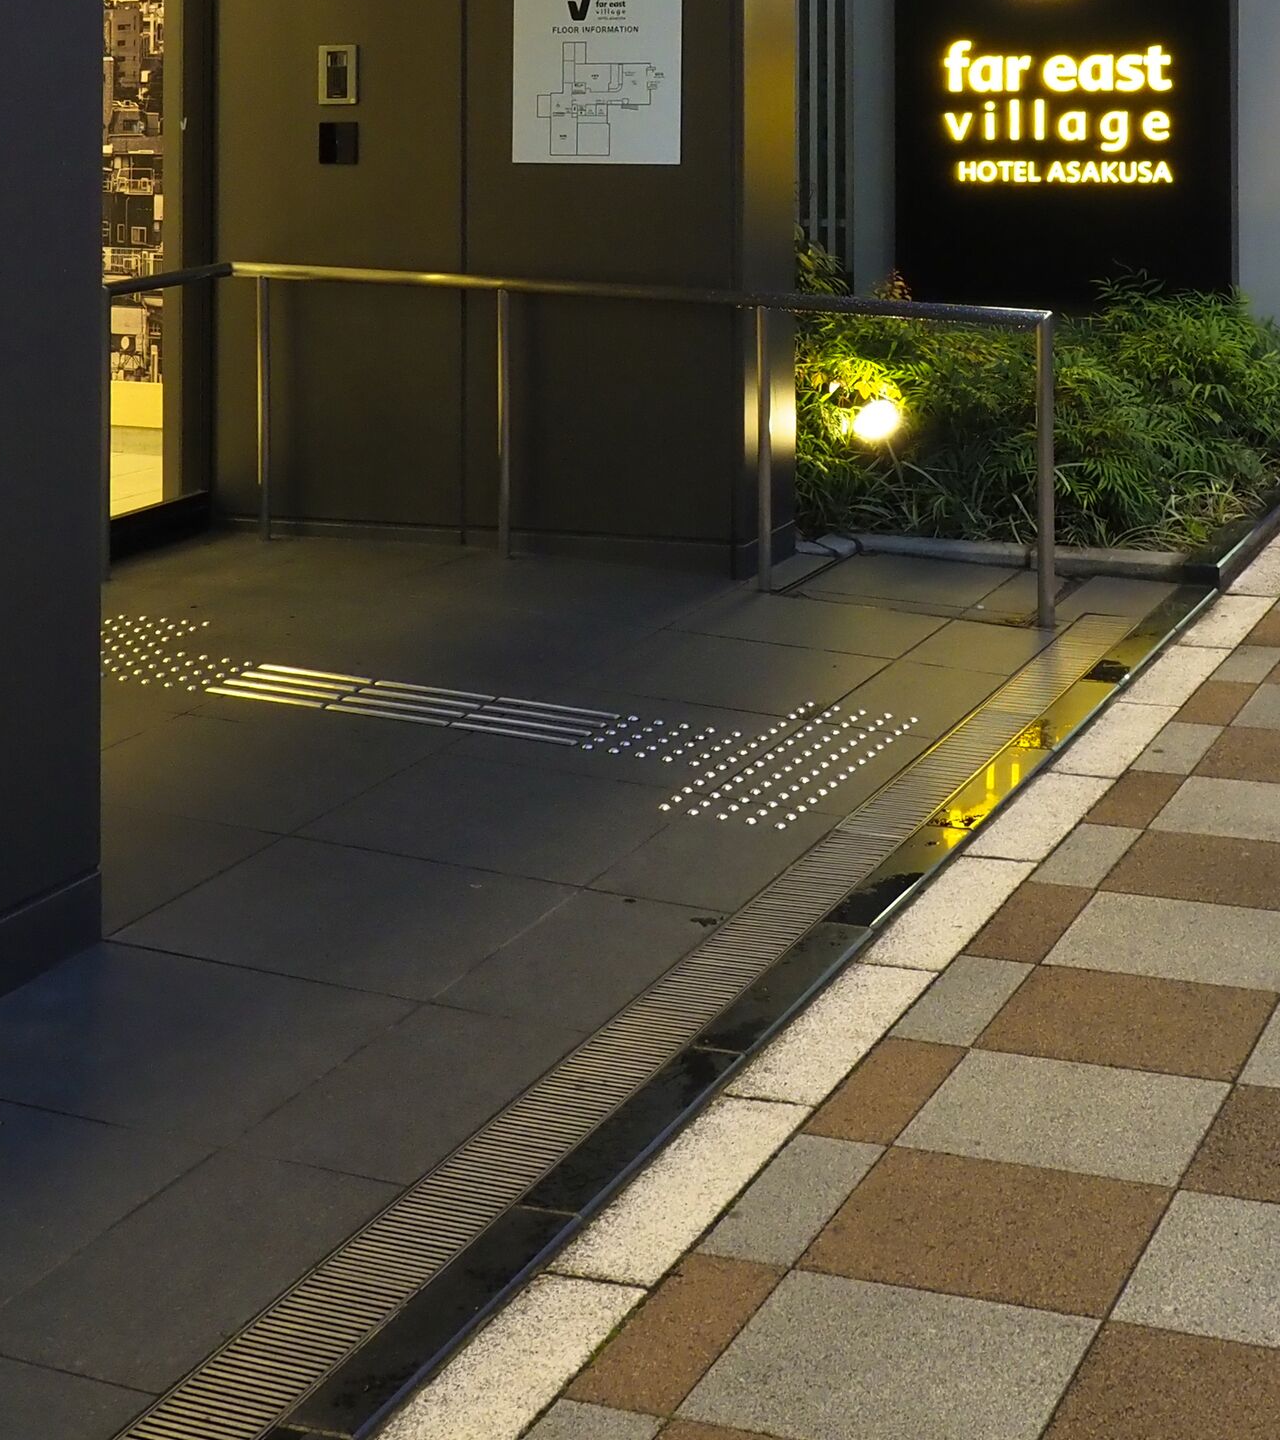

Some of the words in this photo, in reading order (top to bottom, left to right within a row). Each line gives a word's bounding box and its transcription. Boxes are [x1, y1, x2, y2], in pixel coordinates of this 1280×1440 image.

[596, 0, 607, 8] far
[609, 0, 626, 8] east
[552, 26, 579, 34] FLOOR
[582, 25, 639, 34] INFORMATION
[944, 40, 1031, 93] far
[1043, 45, 1173, 93] east
[944, 99, 1171, 152] village
[958, 160, 1041, 183] HOTEL
[1047, 160, 1173, 184] ASAKUSA
